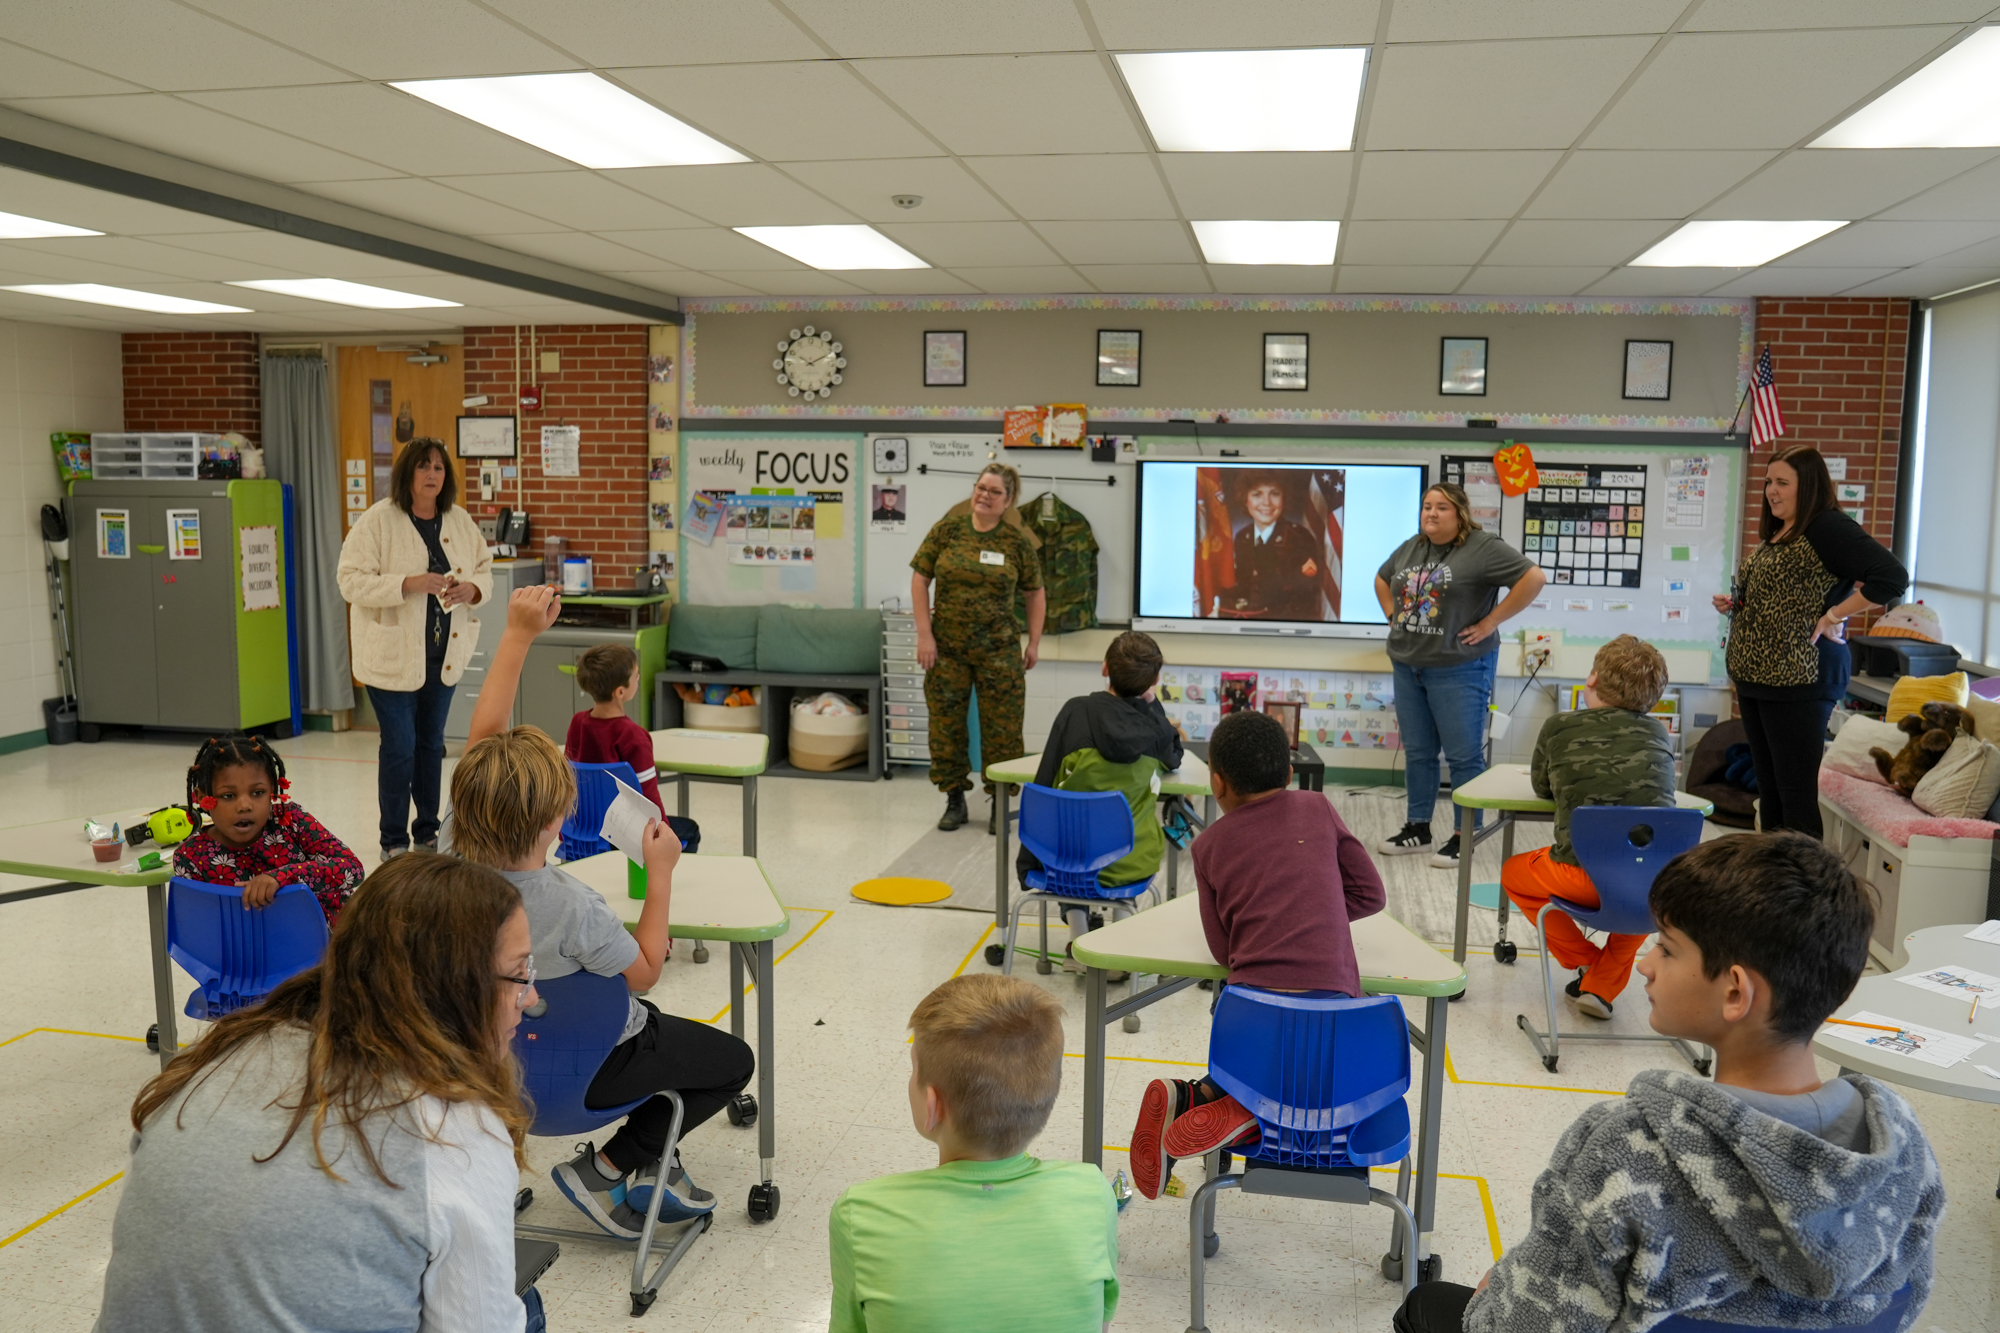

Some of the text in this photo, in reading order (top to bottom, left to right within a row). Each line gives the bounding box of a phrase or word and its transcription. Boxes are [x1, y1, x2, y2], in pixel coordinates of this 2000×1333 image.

[1272, 358, 1299, 366] HAPPY
[1007, 424, 1037, 441] Turkey
[699, 449, 849, 484] weekly FOCUS
[1540, 475, 1635, 485] November 2024
[1633, 508, 1638, 517] 2
[1548, 522, 1554, 531] 4
[1564, 524, 1570, 532] 5
[1580, 524, 1586, 532] 6
[1596, 524, 1602, 532] 7
[1614, 524, 1619, 532] 8
[1632, 525, 1637, 533] 9
[1527, 538, 1552, 547] 10 11
[1416, 625, 1444, 636] FEELS
[1162, 672, 1177, 684] Cc
[1186, 673, 1203, 685] Dd
[1264, 677, 1279, 690] Gg
[1186, 711, 1201, 724] Qq
[1314, 716, 1330, 728] Vv
[1336, 716, 1358, 728] Ww
